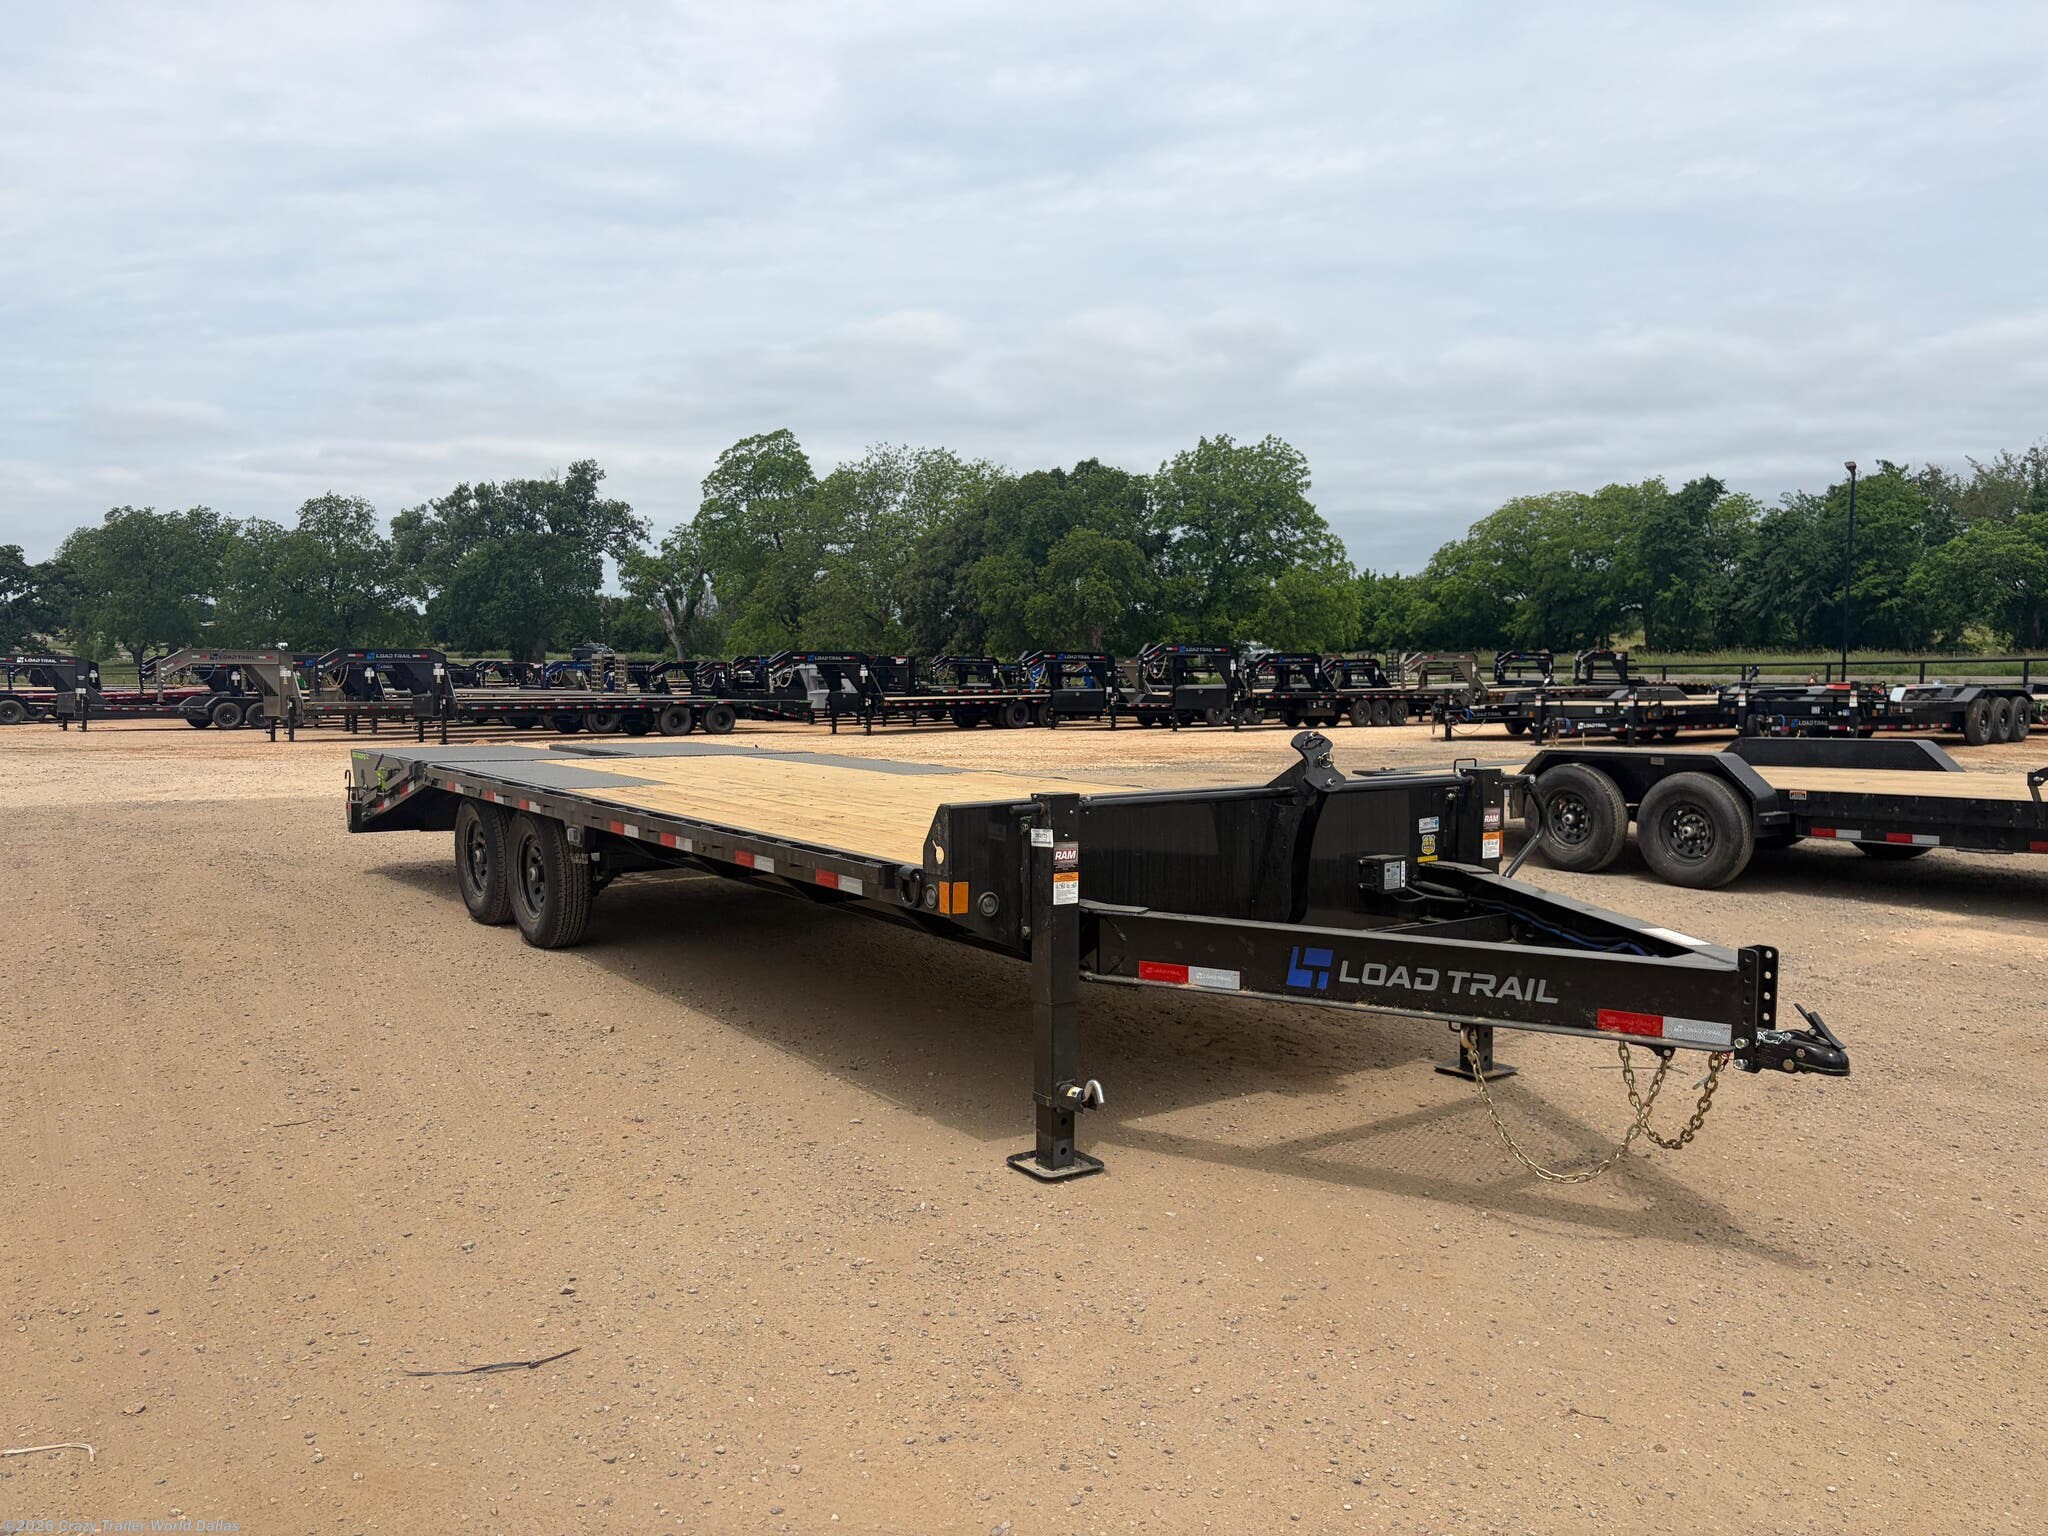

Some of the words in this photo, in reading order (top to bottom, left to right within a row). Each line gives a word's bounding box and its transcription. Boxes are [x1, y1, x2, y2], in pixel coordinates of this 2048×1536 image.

[1484, 814, 1499, 824] RAM
[1055, 850, 1077, 861] RAM
[1338, 960, 1440, 991] LOAD
[1447, 970, 1559, 1004] TRAIL
